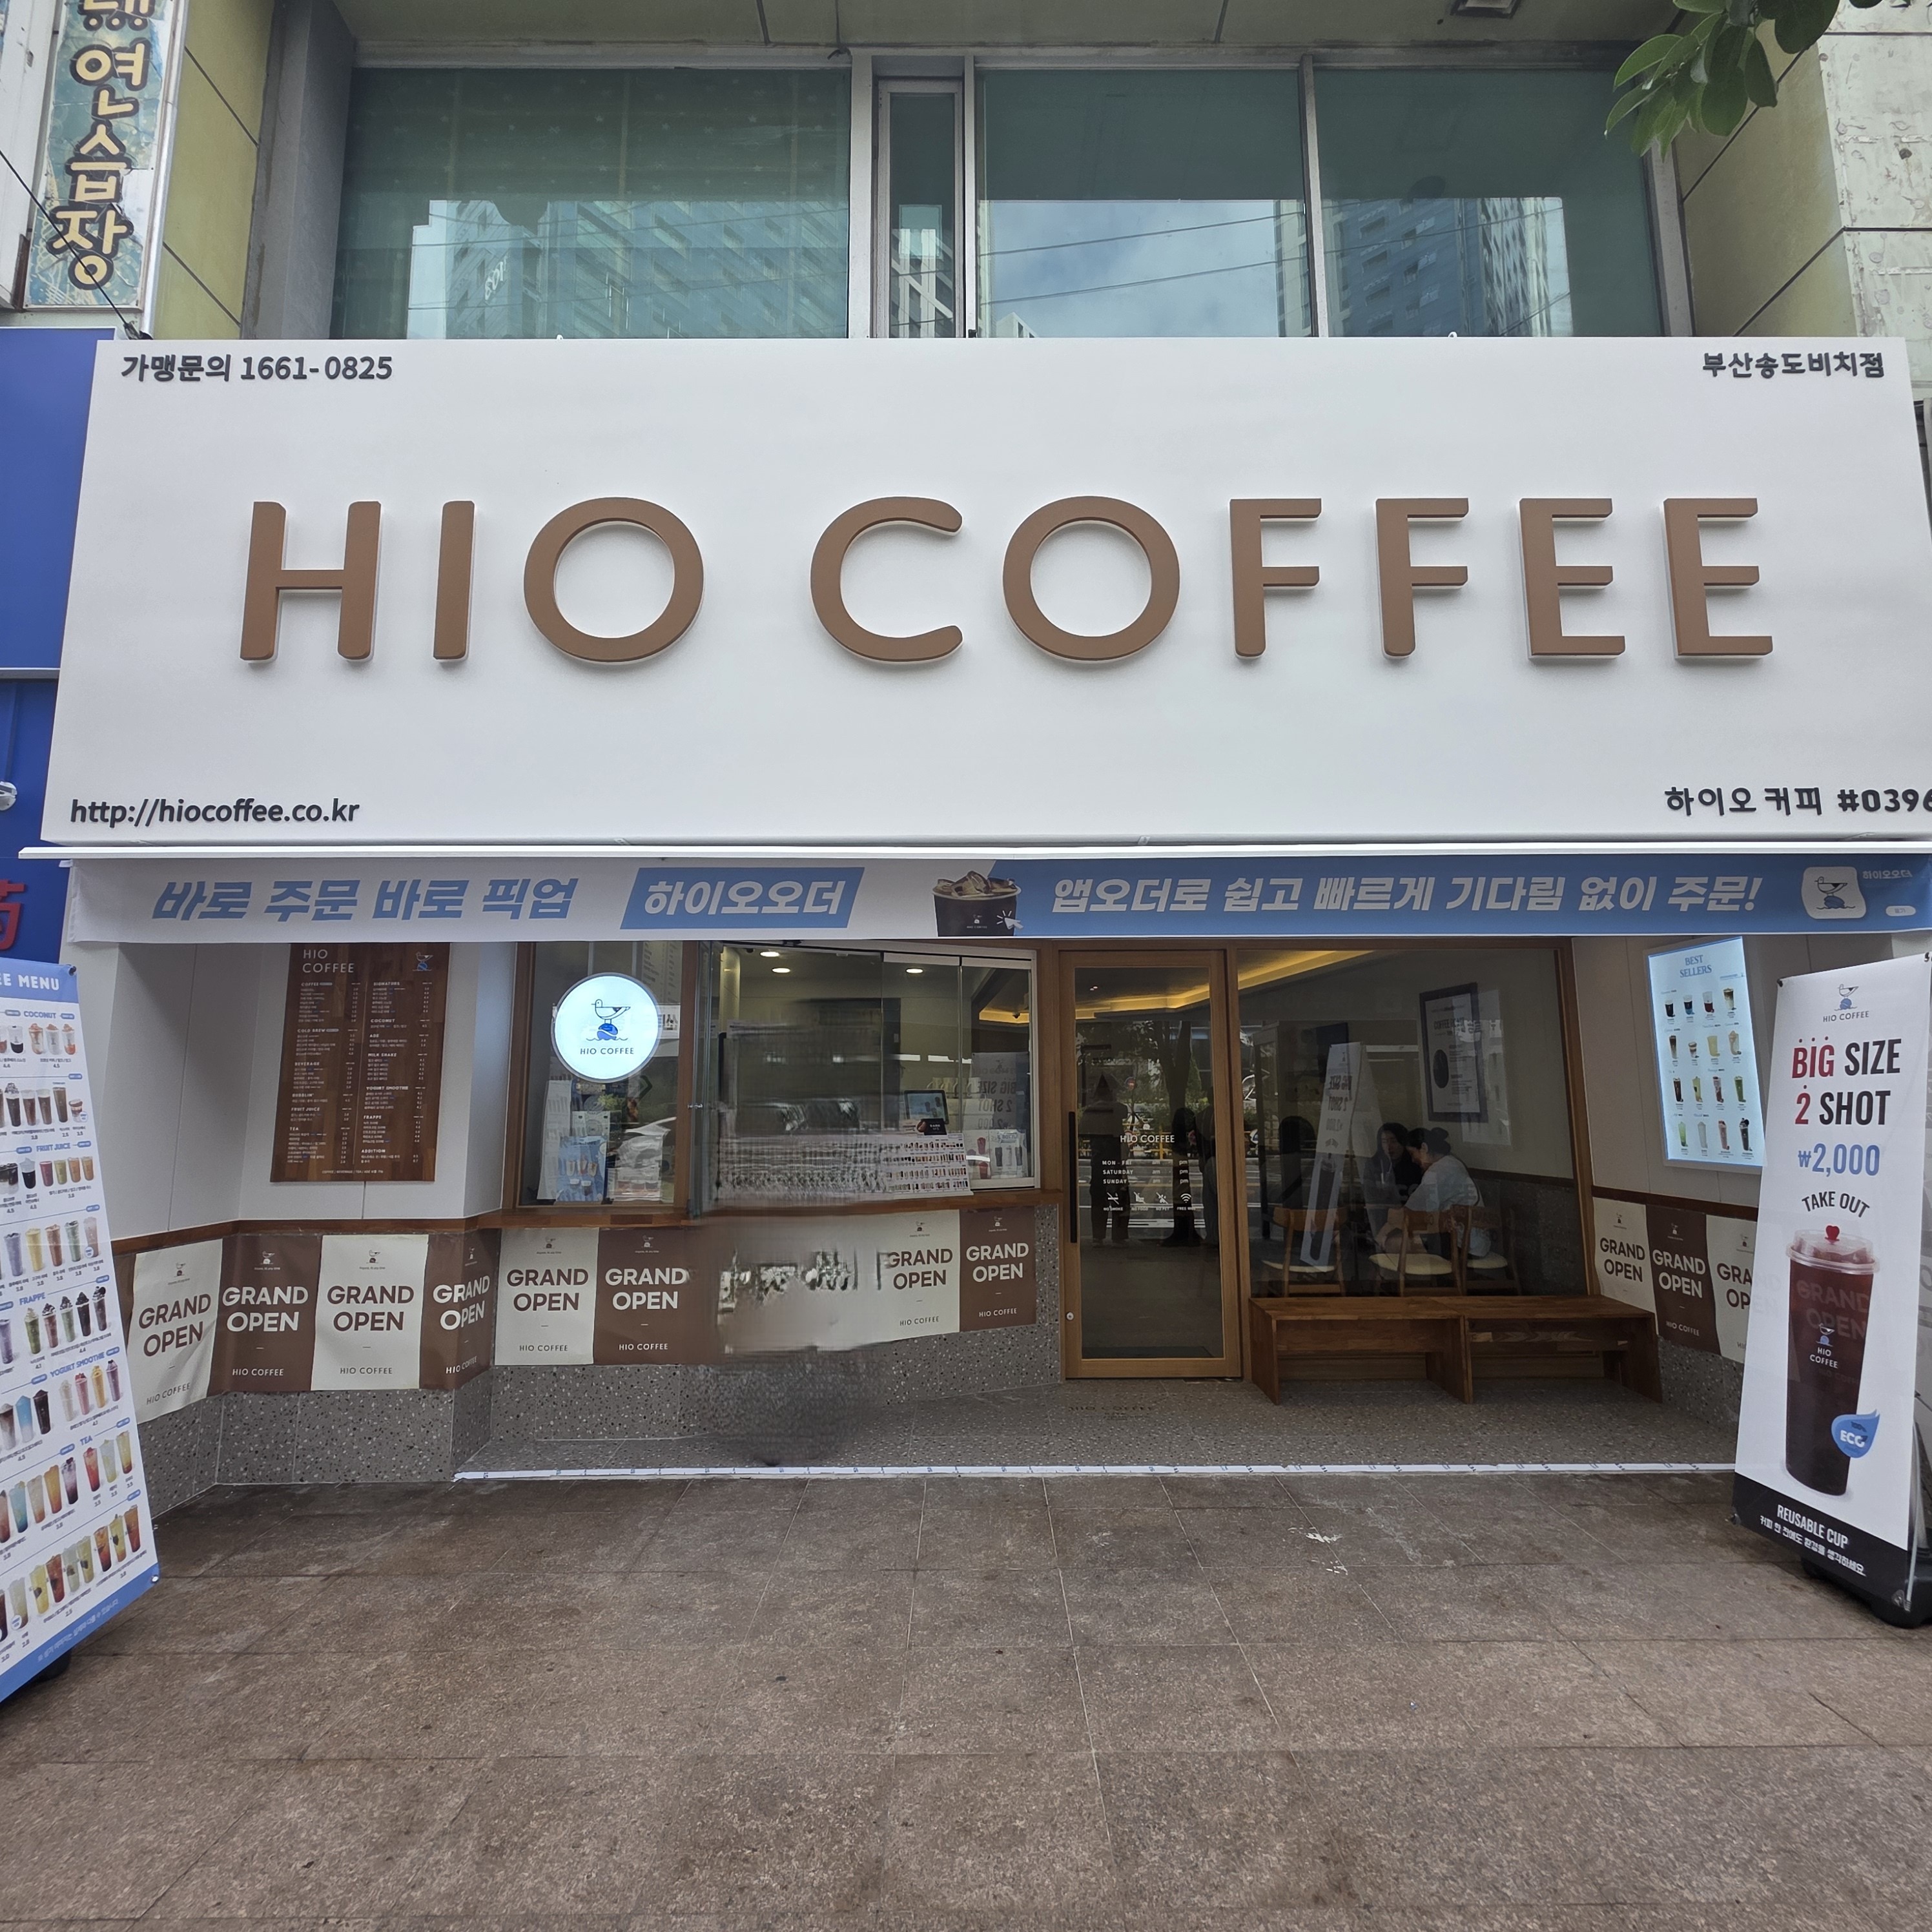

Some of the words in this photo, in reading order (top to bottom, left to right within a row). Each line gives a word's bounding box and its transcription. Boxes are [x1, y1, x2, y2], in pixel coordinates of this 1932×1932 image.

[121, 354, 232, 382] 가맹문의
[241, 356, 393, 380] 1661-0825
[1703, 351, 1884, 378] 부산송도비치점
[240, 497, 704, 664] HIO
[810, 495, 1773, 663] COFFEE
[70, 798, 360, 827] http://hiocoffee.co.kr
[152, 880, 252, 921] 바로
[264, 879, 361, 923] 주문
[372, 879, 470, 921] 바로
[482, 878, 579, 921] 픽업
[644, 879, 847, 916] 하이오오더
[1052, 878, 1211, 913] 앱오더로
[1224, 877, 1304, 912] 쉽고
[1313, 876, 1435, 911] 빠르게
[1446, 876, 1566, 912] 기다림
[1578, 876, 1658, 912] 없이
[1668, 876, 1763, 912] 주문!
[303, 949, 328, 960] HIO
[1685, 954, 1703, 966] BEST
[302, 963, 355, 973] COFFEE
[1680, 965, 1712, 978] SELLERS
[18, 974, 59, 991] MENU
[23, 1011, 57, 1019] COCONUT
[1839, 1011, 1869, 1020] COFFEE
[1792, 1043, 1835, 1078] BIG
[1844, 1038, 1902, 1076] SIZE
[1794, 1092, 1811, 1125] 2
[1819, 1090, 1891, 1125] SHOT
[1120, 1135, 1138, 1143] HIO
[1140, 1135, 1175, 1143] COFFEE
[1802, 1191, 1836, 1212] TAKE
[1840, 1193, 1870, 1218] OUT
[889, 1248, 953, 1268] GRAND
[966, 1242, 1029, 1262] GRAND
[1599, 1237, 1646, 1260] GRAND
[972, 1262, 1023, 1282] OPEN
[1604, 1259, 1643, 1282] OPEN
[1652, 1249, 1706, 1275] GRAND
[507, 1268, 589, 1287] GRAND
[605, 1267, 687, 1286] GRAND
[892, 1269, 947, 1290] OPEN
[1716, 1263, 1752, 1286] GRA
[327, 1285, 415, 1304] GRAND
[432, 1275, 490, 1304] GRAND
[1658, 1272, 1703, 1299] OPEN
[19, 1292, 46, 1305] FRAPPE
[221, 1286, 309, 1306] GRAND
[513, 1292, 580, 1312] OPEN
[612, 1291, 678, 1311] OPEN
[138, 1293, 212, 1330] GRAND
[226, 1311, 300, 1332] OPEN
[333, 1311, 404, 1331] OPEN
[440, 1300, 486, 1331] OPEN
[914, 1316, 940, 1324] COFFEE
[993, 1308, 1018, 1316] COFFEE
[143, 1321, 203, 1357] OPEN
[619, 1343, 635, 1351] HIO
[1817, 1346, 1831, 1356] HIO
[50, 1363, 75, 1378] YOGURT
[76, 1352, 105, 1367] SMOOTHIE
[1809, 1355, 1838, 1368] COFFEE
[251, 1368, 284, 1377] COFFEE
[147, 1392, 160, 1405] HIO
[161, 1382, 190, 1400] COFFEE
[80, 1435, 93, 1446] TEA
[1777, 1505, 1825, 1539] REUSABLE
[1826, 1528, 1849, 1549] CUP
[1760, 1515, 1773, 1529] 커피
[1827, 1548, 1867, 1577] 생각하세요
